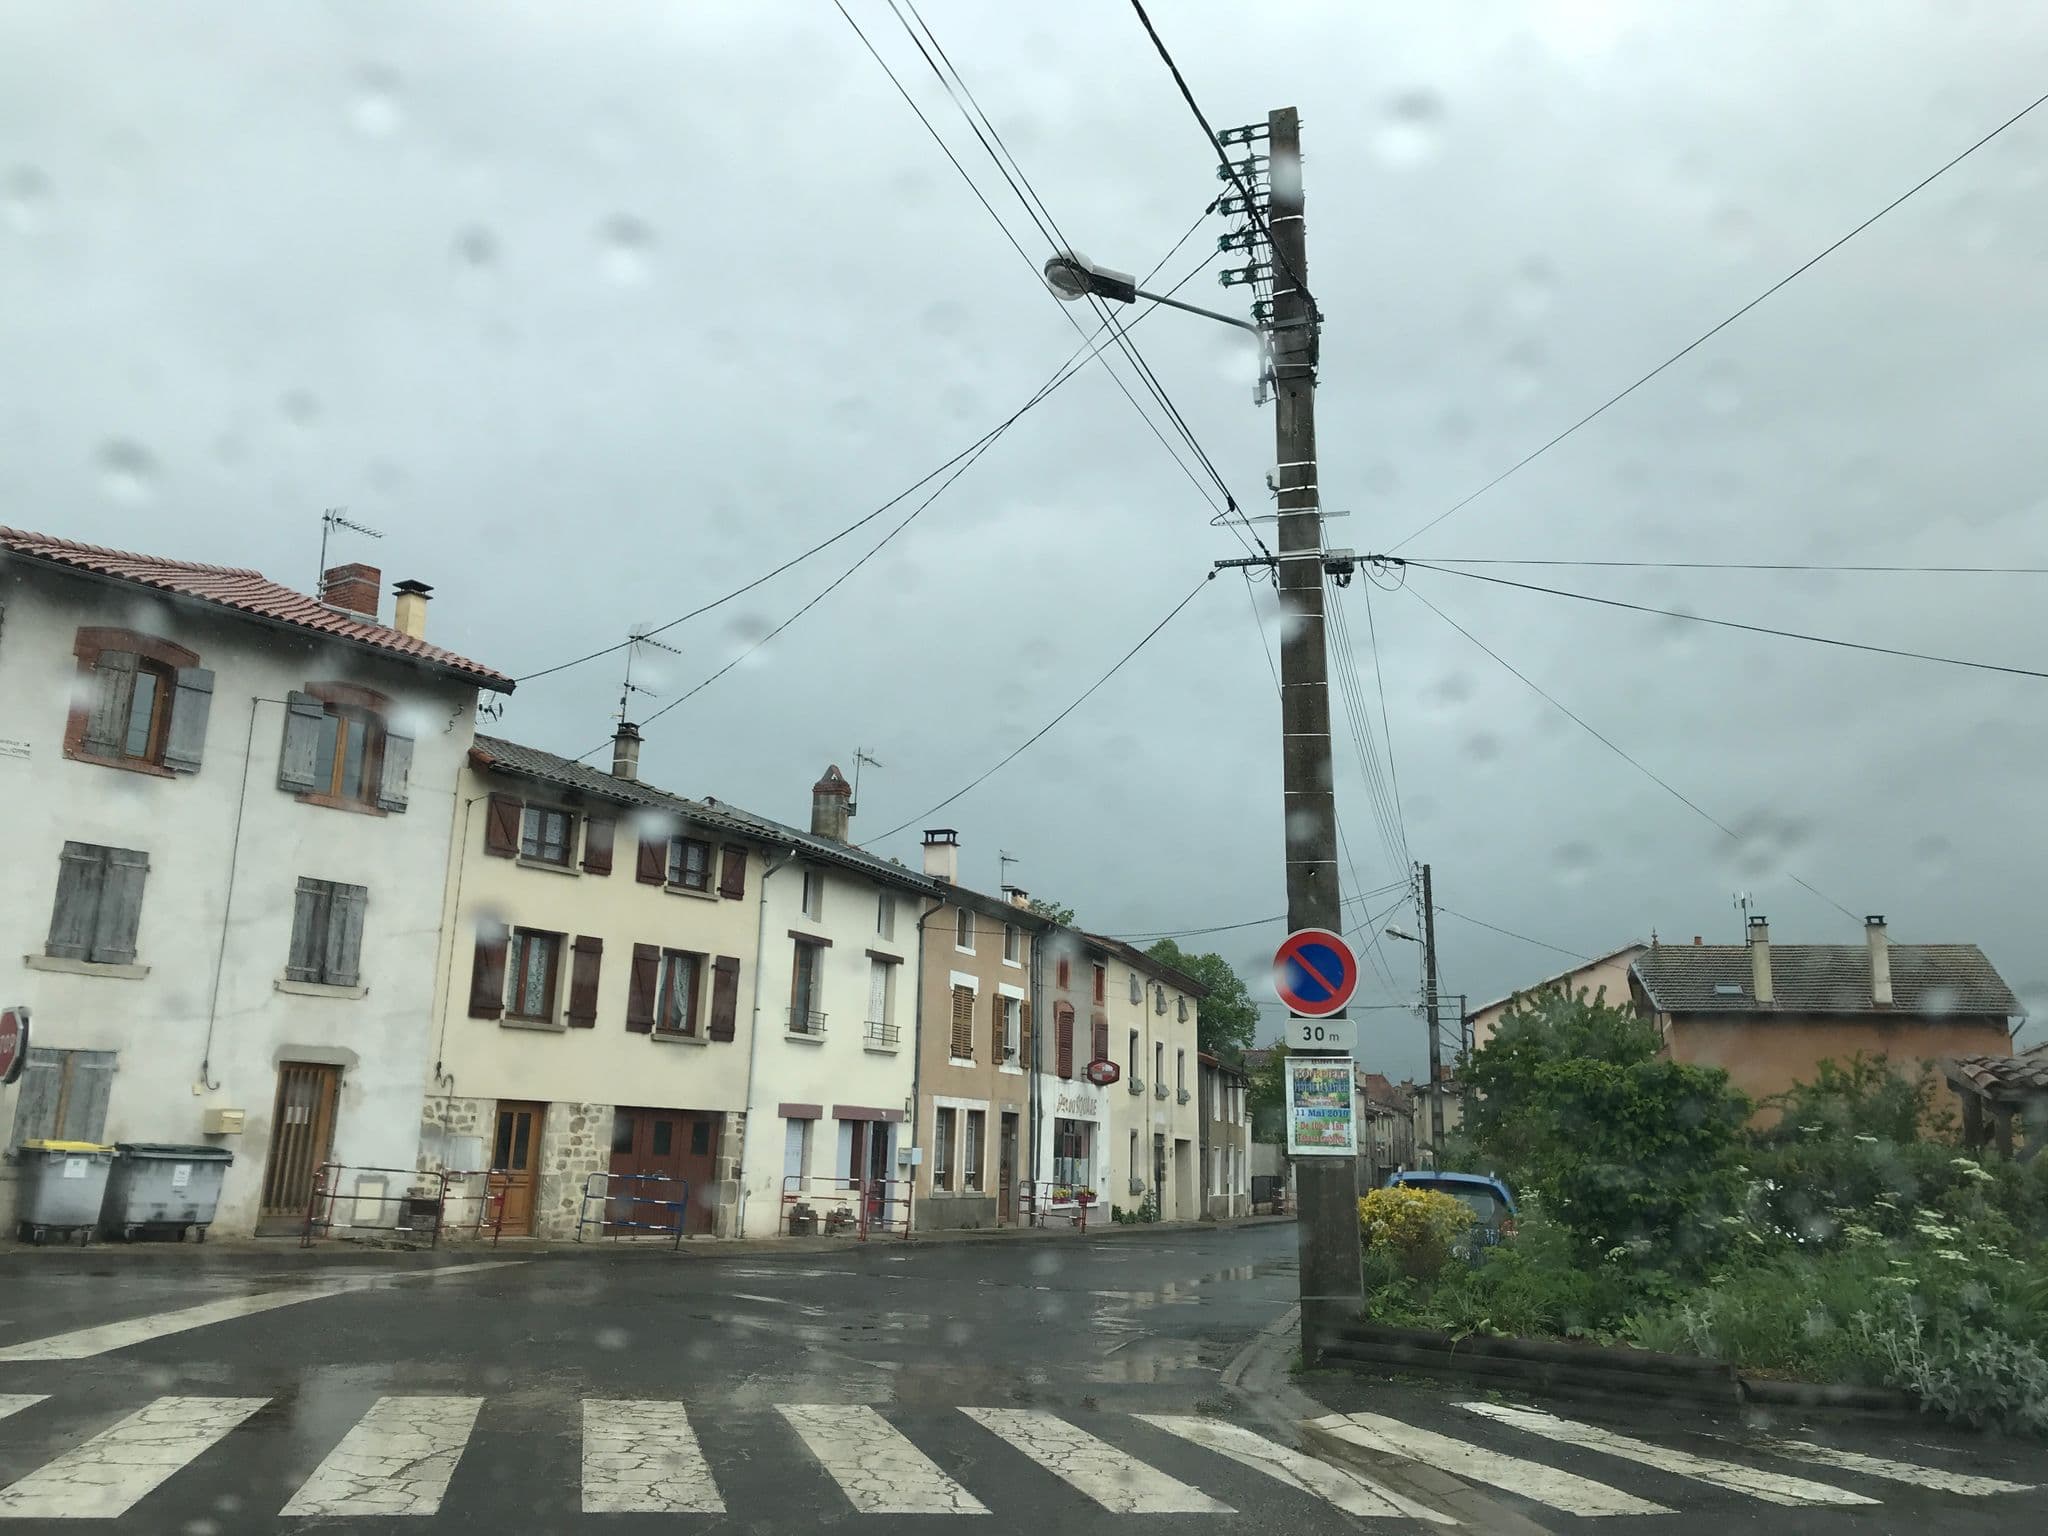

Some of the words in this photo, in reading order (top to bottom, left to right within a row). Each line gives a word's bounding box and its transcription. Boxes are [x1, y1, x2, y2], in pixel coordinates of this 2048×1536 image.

[1303, 1026, 1324, 1041] 30
[1329, 1033, 1340, 1041] m
[1308, 1109, 1325, 1117] Mai
